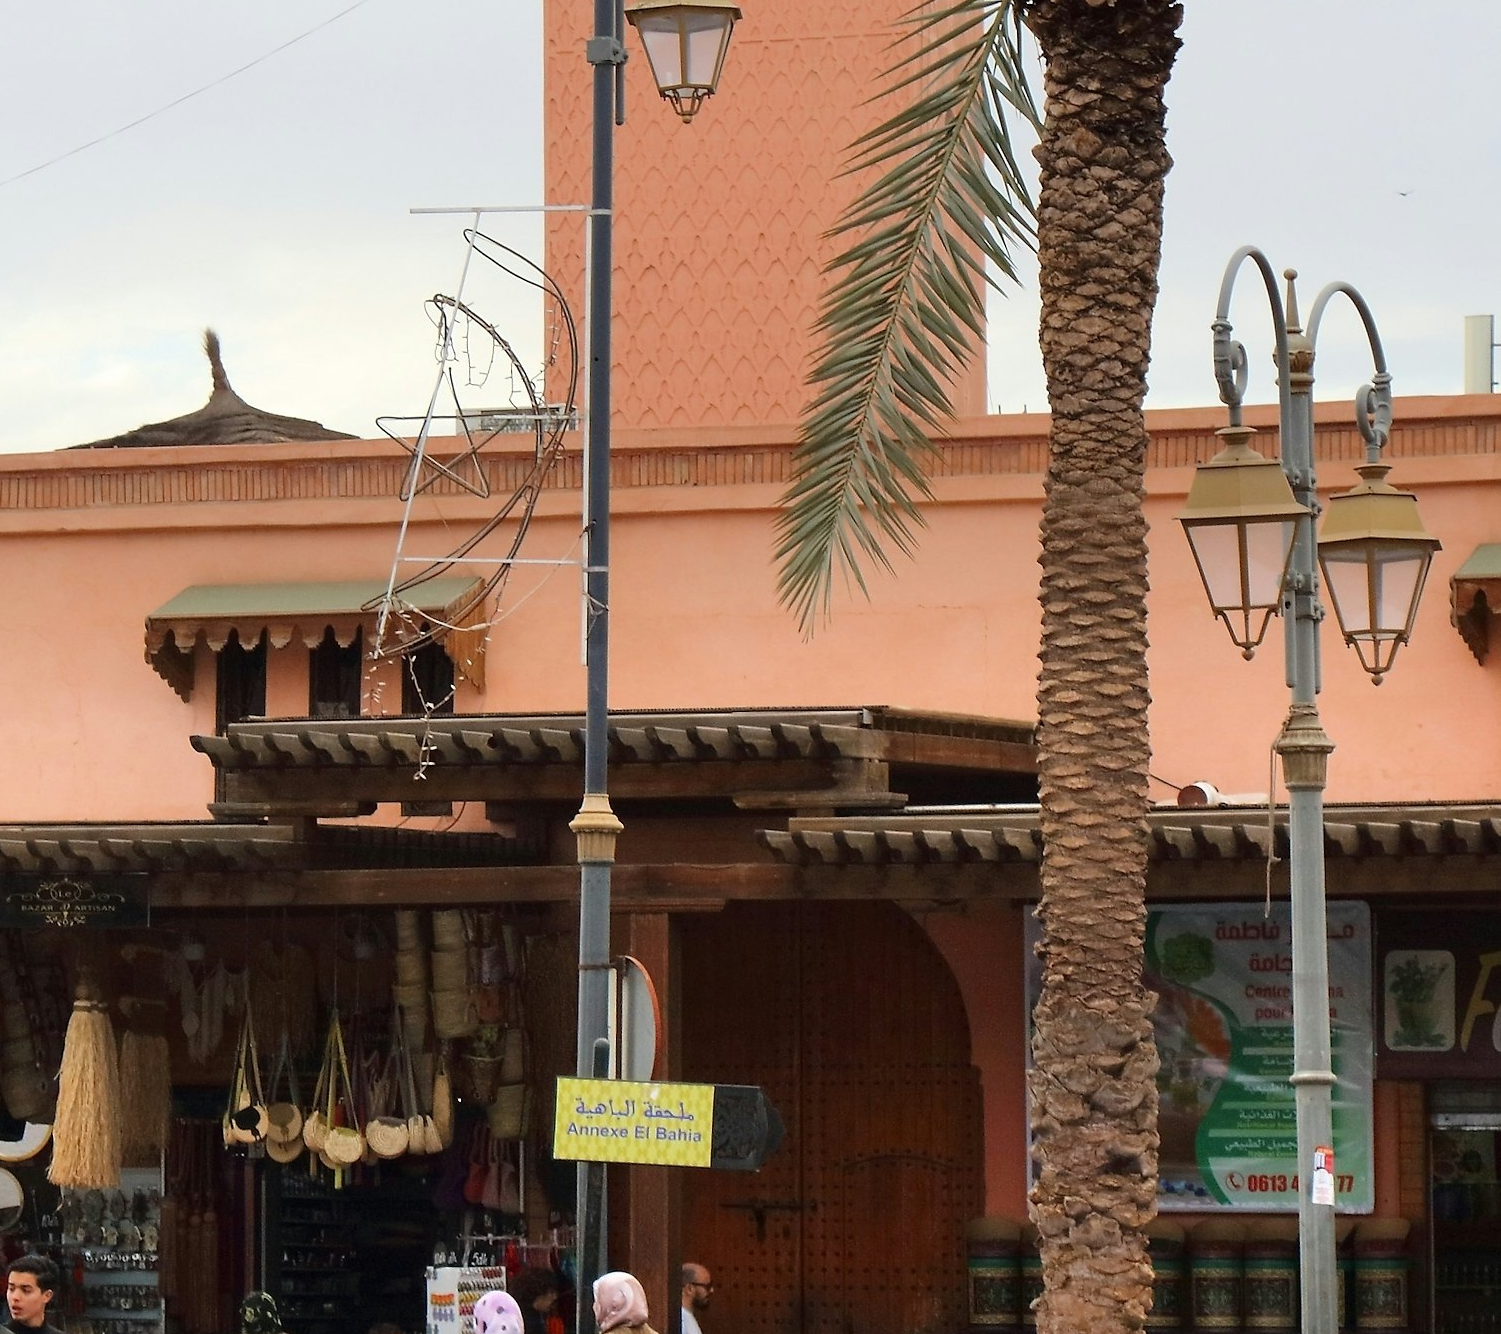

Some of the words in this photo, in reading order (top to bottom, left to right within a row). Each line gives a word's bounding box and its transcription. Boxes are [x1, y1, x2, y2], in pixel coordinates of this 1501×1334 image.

[1245, 984, 1291, 999] Centre
[575, 1097, 635, 1120] الباهية
[643, 1101, 695, 1122] ملحقة
[566, 1122, 629, 1138] Annexe
[635, 1126, 649, 1139] El
[656, 1127, 702, 1143] Bahia
[1247, 1175, 1288, 1193] 0613
